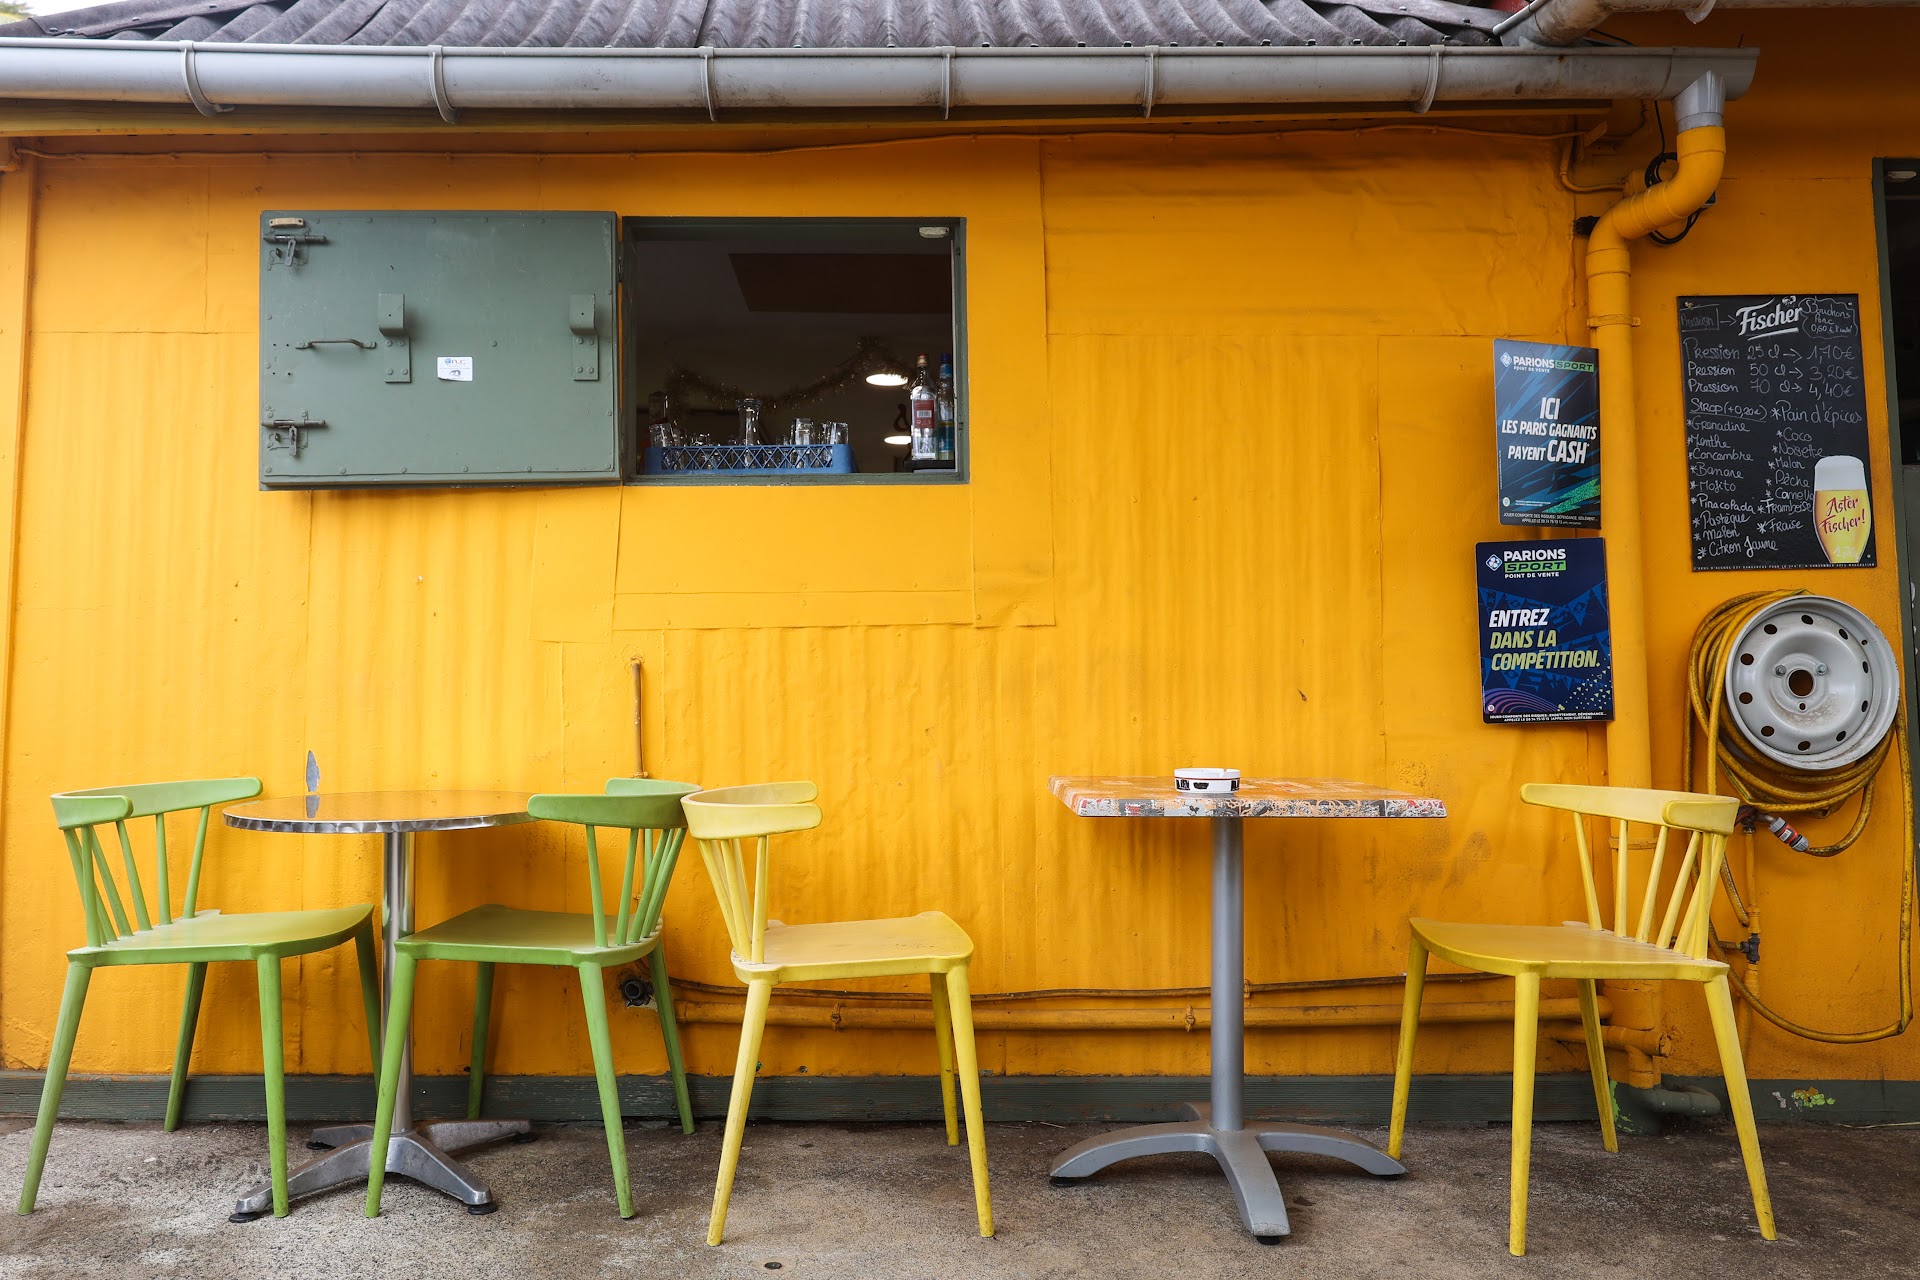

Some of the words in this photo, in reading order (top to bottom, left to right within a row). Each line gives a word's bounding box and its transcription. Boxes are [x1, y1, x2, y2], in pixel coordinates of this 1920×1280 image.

[1681, 313, 1714, 327] Pression
[1736, 297, 1802, 336] Fischer
[1811, 324, 1827, 334] 0,50
[1683, 337, 1740, 360] Pression
[1747, 345, 1765, 360] 25
[1768, 344, 1779, 358] cl
[1806, 345, 1855, 364] 1,70€
[1513, 356, 1555, 369] PARIONS
[1556, 361, 1593, 371] SPORT
[1688, 361, 1735, 376] Pression
[1750, 363, 1768, 376] 50
[1774, 364, 1785, 376] cl
[1809, 365, 1858, 384] 3,20€
[1688, 378, 1738, 393] Pression
[1750, 378, 1770, 394] 70
[1780, 380, 1790, 392] cl
[1809, 383, 1855, 400] 4,40€
[1539, 397, 1561, 420] ICI
[1776, 400, 1808, 421] Pain
[1502, 420, 1518, 434] LES
[1519, 421, 1547, 436] PARIS
[1549, 423, 1597, 440] GAGNANTS
[1692, 415, 1751, 432] Grenadine
[1691, 433, 1731, 448] Menthe
[1783, 427, 1812, 442] Coco
[1508, 445, 1546, 460] PAYENT
[1779, 441, 1824, 459] Noisette
[1696, 462, 1744, 479] Banane
[1776, 470, 1810, 487] Pêche
[1700, 480, 1736, 493] Mojito
[1760, 498, 1813, 516] Framboise
[1700, 510, 1751, 529] Pastèque
[1765, 518, 1804, 532] Fraise
[1818, 508, 1866, 534] Fischer!
[1504, 549, 1566, 561] PARIONS
[1709, 539, 1741, 556] Citron
[1506, 561, 1565, 571] SPORT
[1489, 608, 1550, 628] ENTREZ
[1490, 630, 1534, 649] DANS
[1537, 630, 1557, 648] LA
[1491, 649, 1601, 671] COMPÉTITION.
